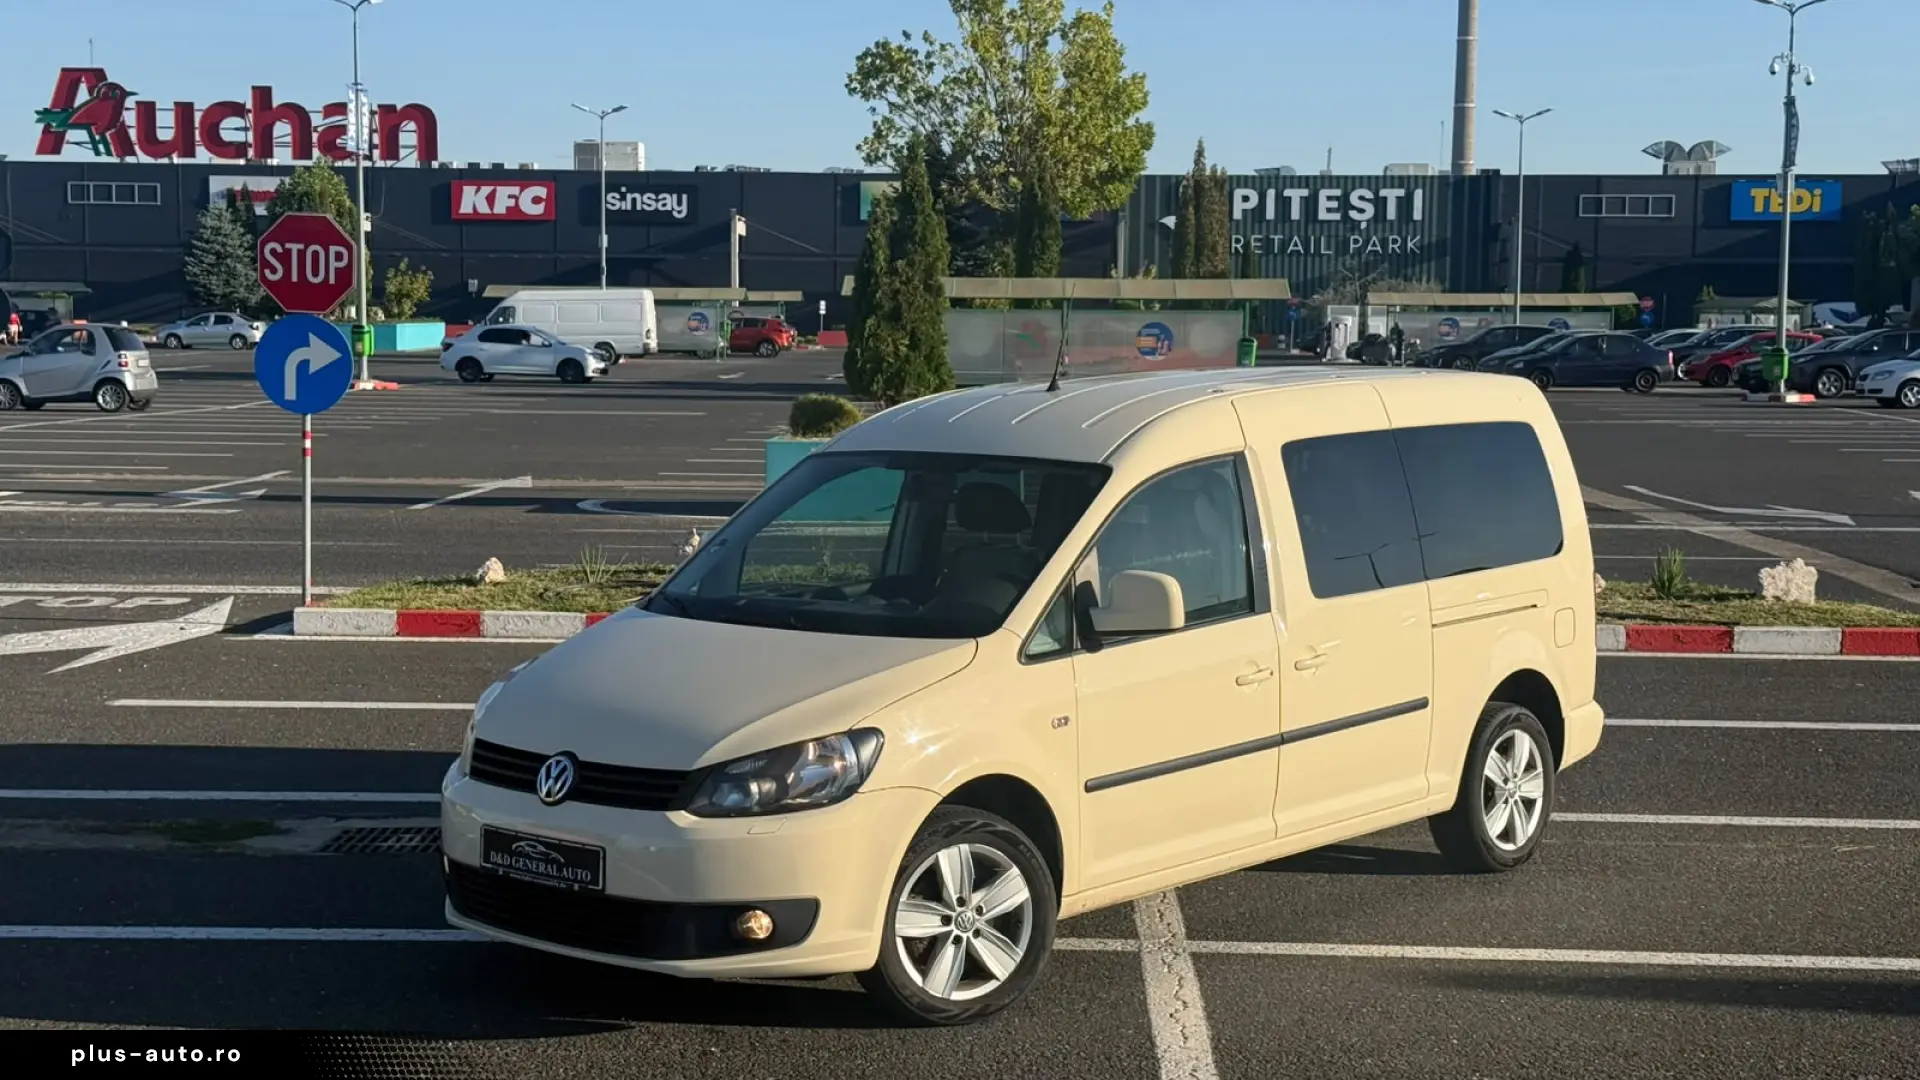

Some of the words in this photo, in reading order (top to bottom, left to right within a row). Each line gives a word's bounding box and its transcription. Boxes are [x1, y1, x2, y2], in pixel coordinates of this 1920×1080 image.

[36, 67, 438, 162] Auchan
[459, 186, 548, 215] KFC
[606, 187, 688, 219] sinsay
[1231, 235, 1333, 254] RETAIL
[1350, 234, 1421, 254] PARK
[263, 241, 349, 285] STOP
[490, 851, 511, 866] D&D
[511, 857, 560, 877] GENERAL
[559, 866, 592, 883] AUTO
